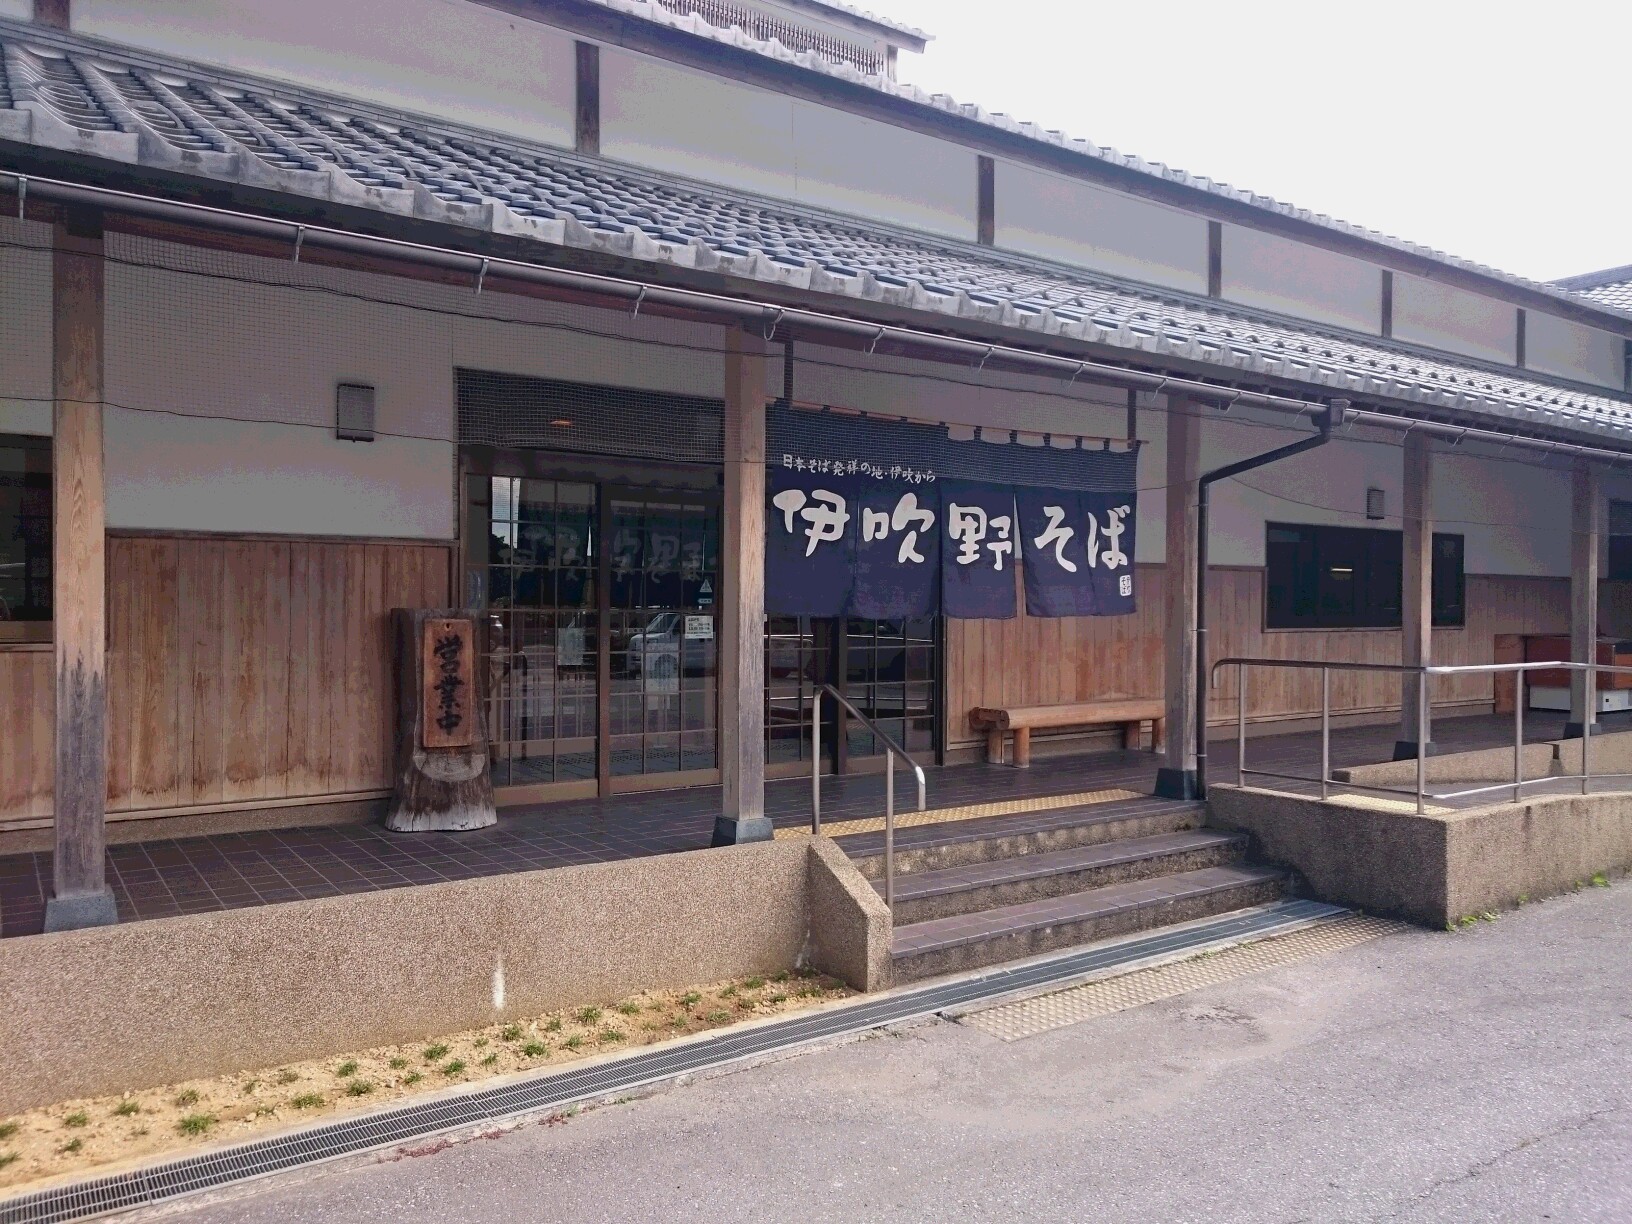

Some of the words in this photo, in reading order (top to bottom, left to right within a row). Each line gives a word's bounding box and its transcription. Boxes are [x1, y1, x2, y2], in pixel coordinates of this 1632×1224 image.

[773, 489, 1131, 573] 伊吹野そば
[434, 634, 465, 736] 営業中
